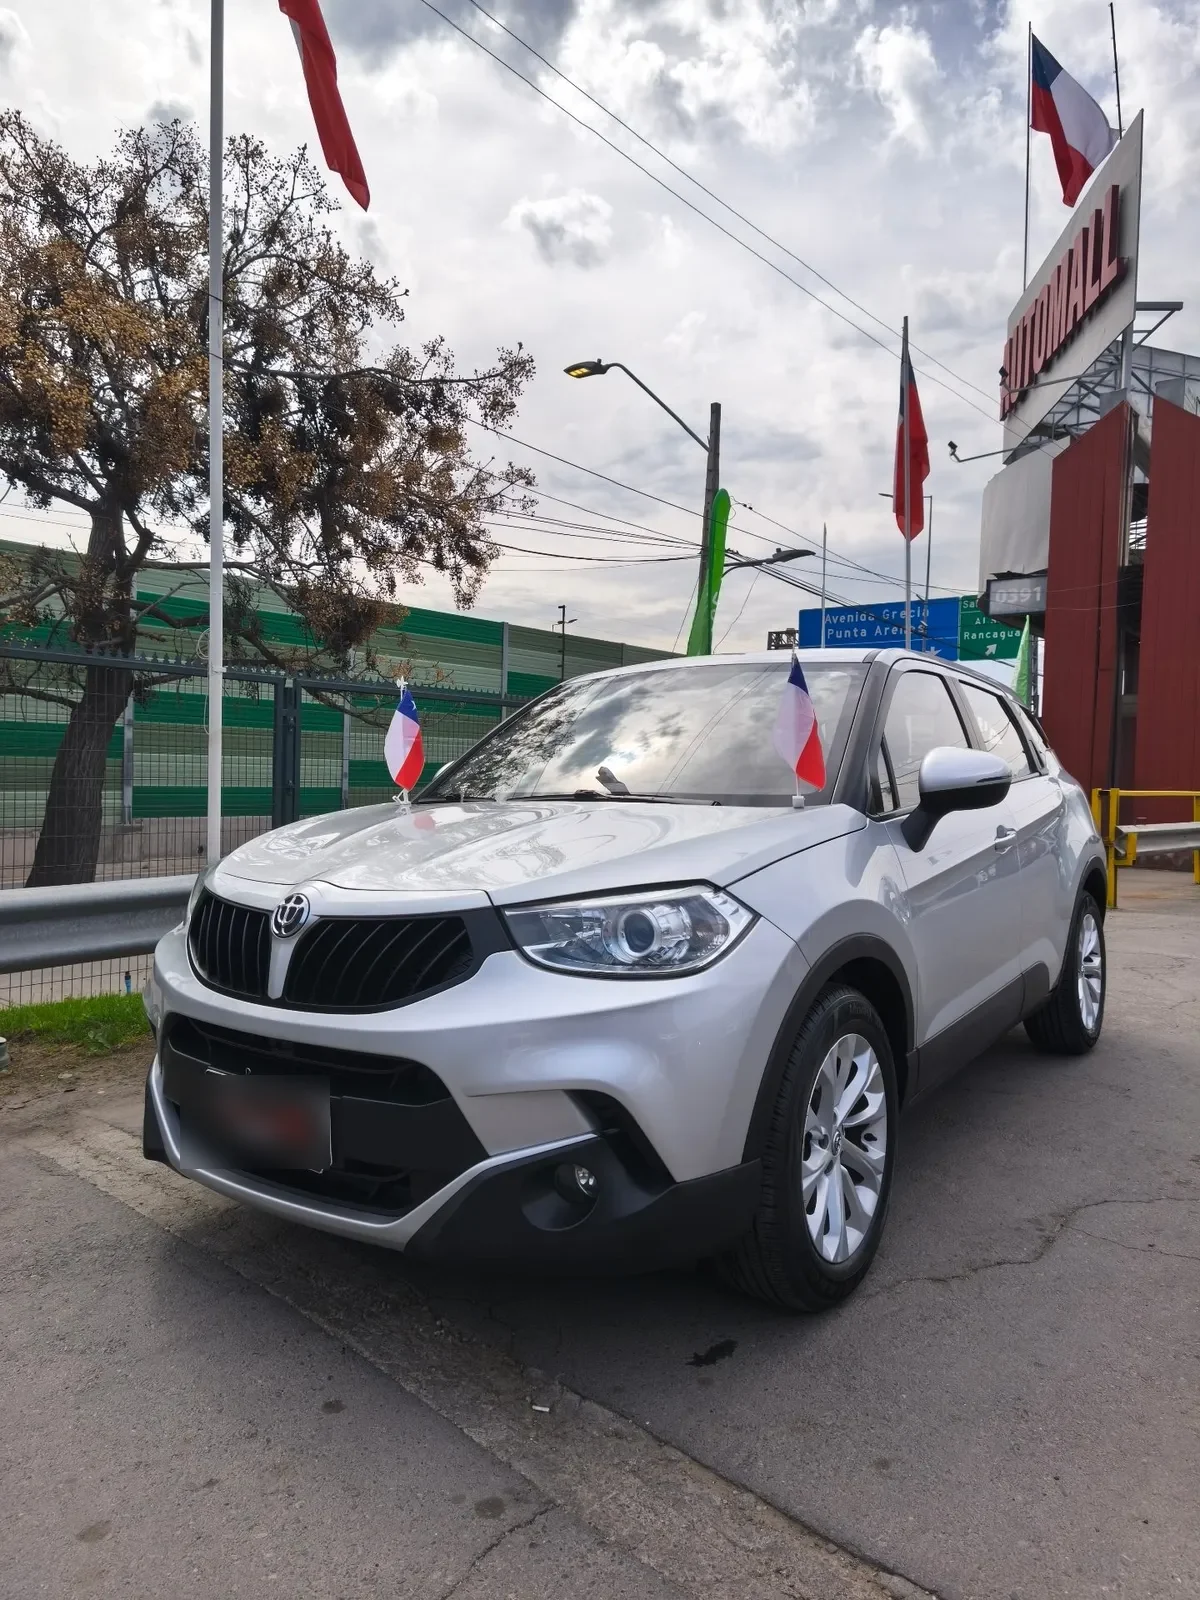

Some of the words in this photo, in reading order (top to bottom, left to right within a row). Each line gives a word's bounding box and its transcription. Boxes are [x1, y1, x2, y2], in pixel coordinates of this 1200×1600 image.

[825, 611, 875, 625] Avenida
[882, 606, 930, 620] Grecia
[827, 627, 867, 639] Punta
[964, 630, 1021, 640] Rancagua
